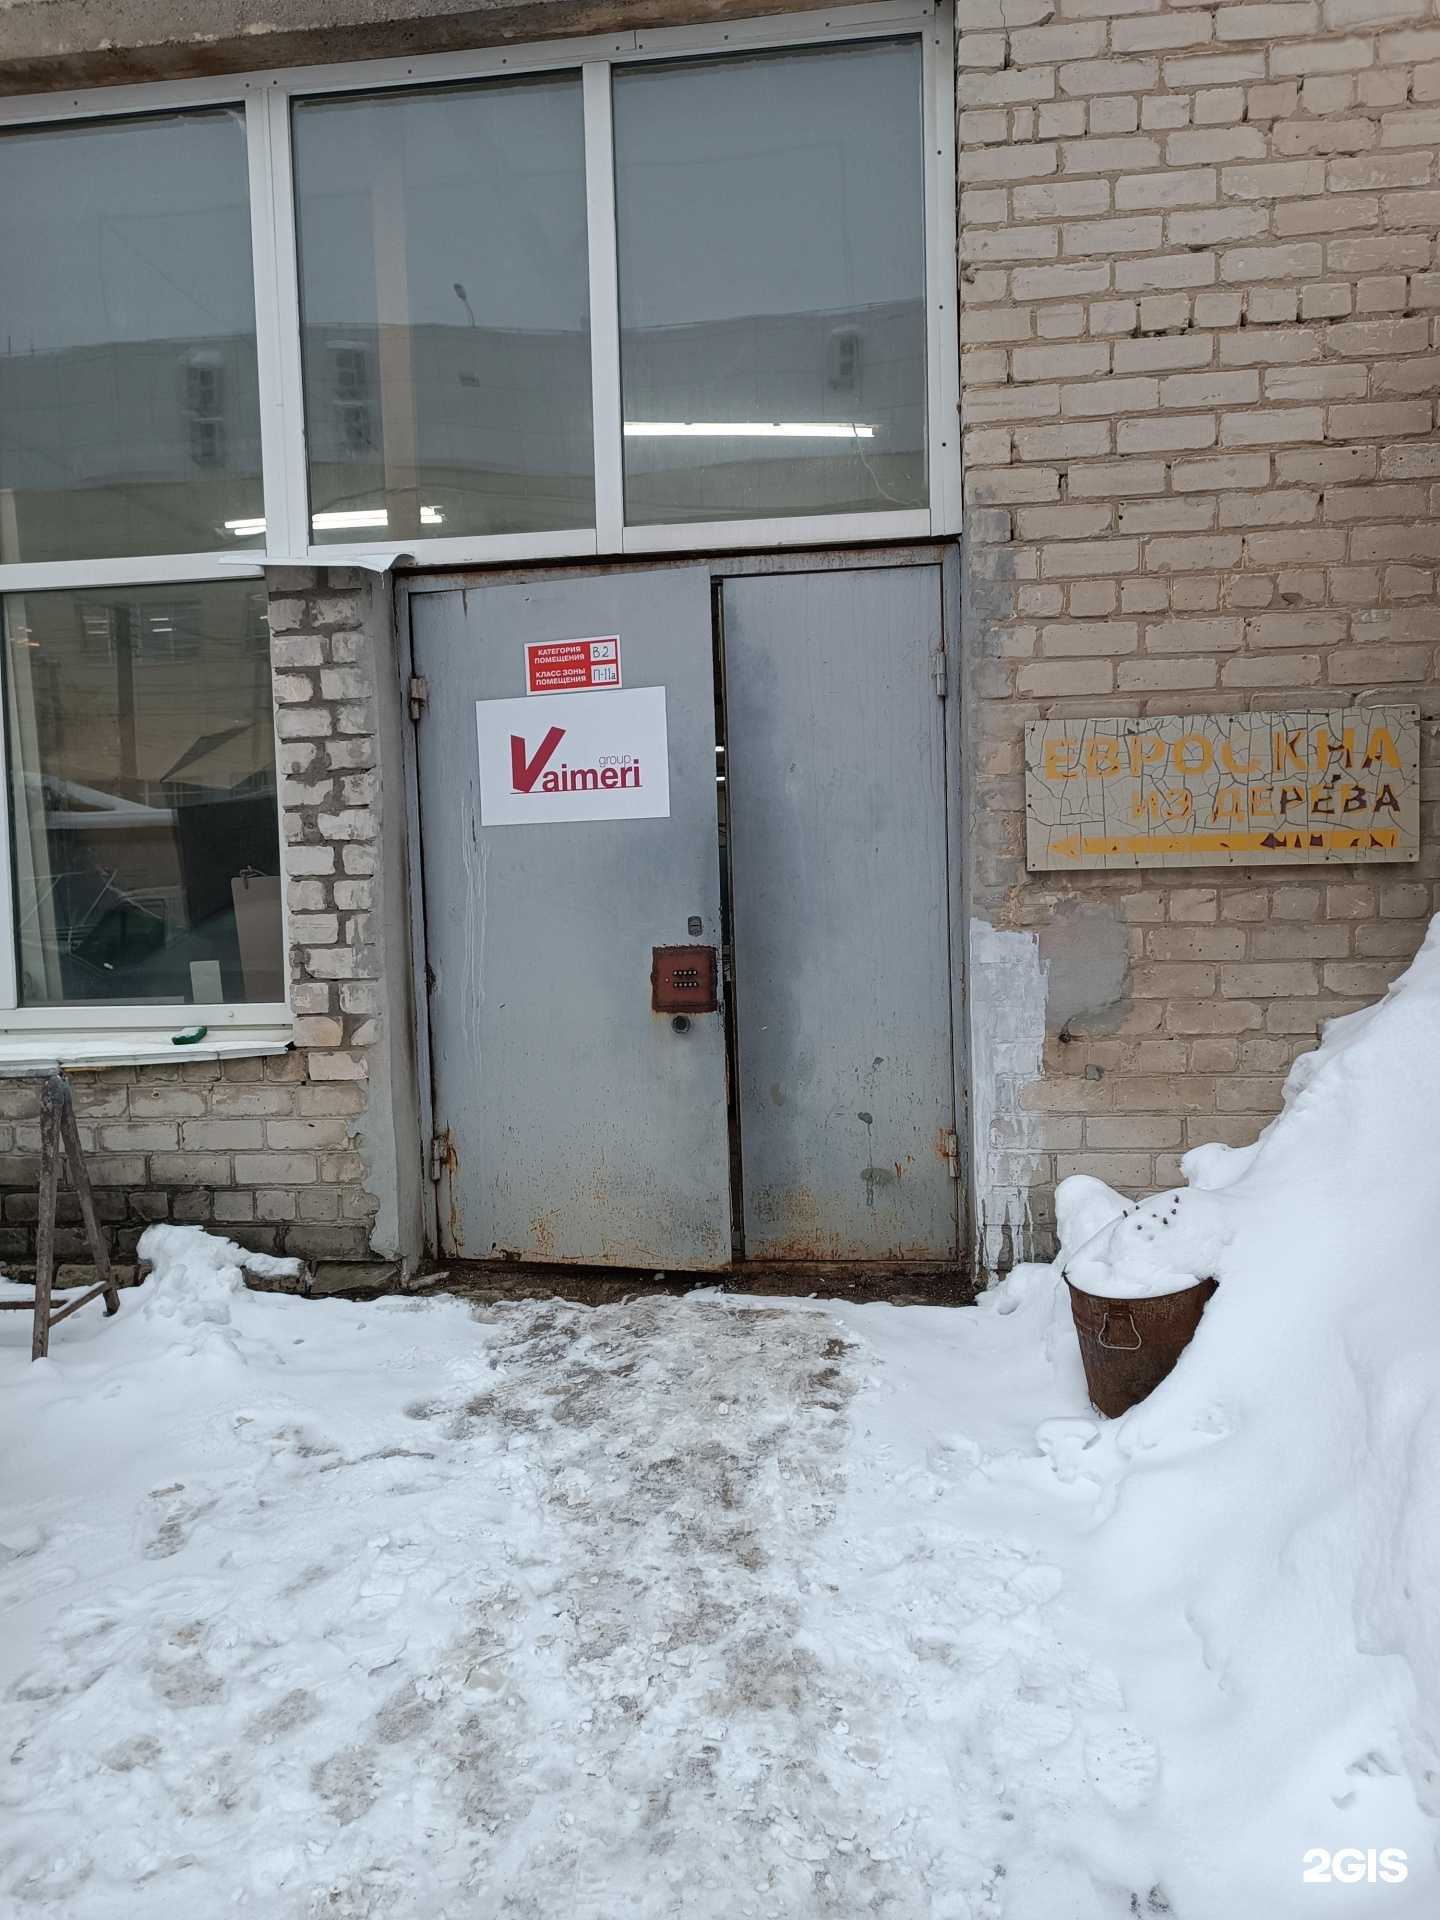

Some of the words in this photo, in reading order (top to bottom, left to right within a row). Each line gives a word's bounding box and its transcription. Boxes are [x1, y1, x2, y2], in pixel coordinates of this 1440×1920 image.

[538, 646, 581, 656] КАТЕГОРИЯ
[534, 653, 585, 664] ПОМЕЩЕНИЯ
[536, 669, 561, 678] КЛАСС
[562, 667, 586, 677] ЗОНЫ
[535, 675, 587, 686] ПОМЕЩЕНИЯ
[510, 726, 641, 793] Vaimeri
[598, 753, 632, 768] group
[1131, 788, 1192, 821] ИЗ
[1211, 783, 1401, 823] ДЕРЕВА
